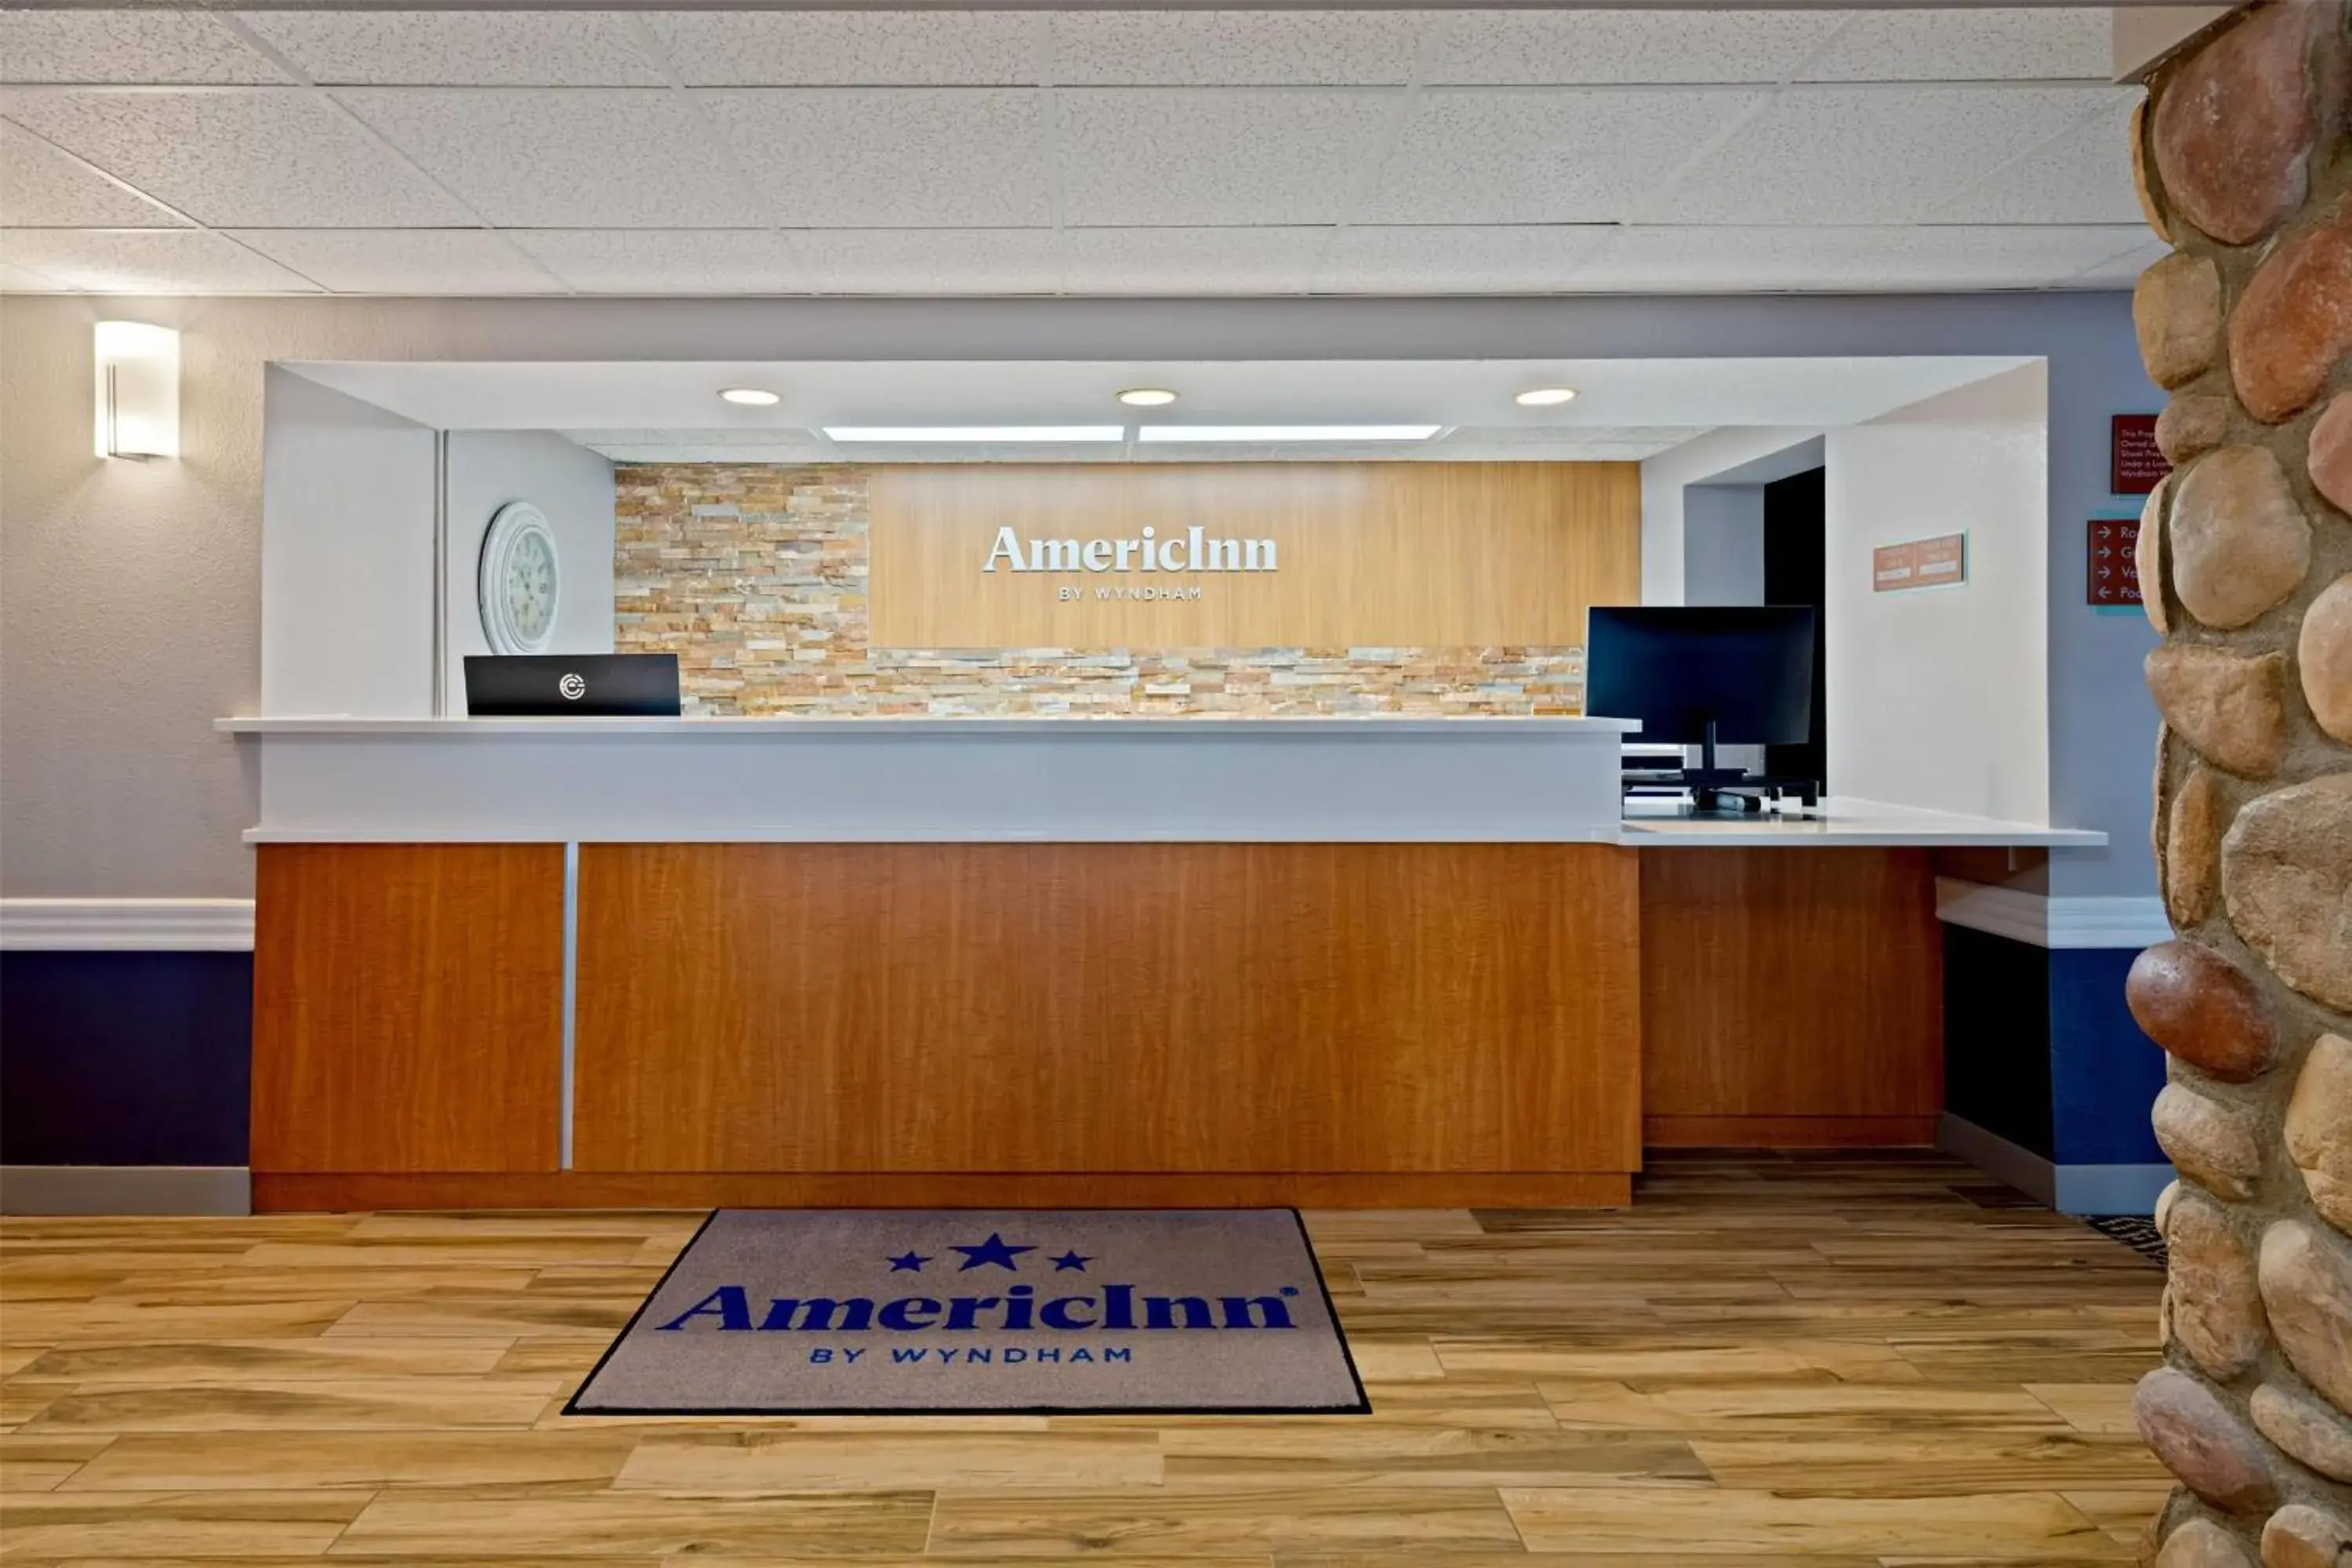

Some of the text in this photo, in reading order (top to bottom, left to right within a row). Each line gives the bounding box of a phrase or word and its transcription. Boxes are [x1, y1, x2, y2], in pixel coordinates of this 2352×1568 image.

[982, 526, 1278, 572] AmericInn
[1058, 586, 1202, 601] BY WYNDHAM
[809, 1347, 1132, 1364] BY WYNDHAM
